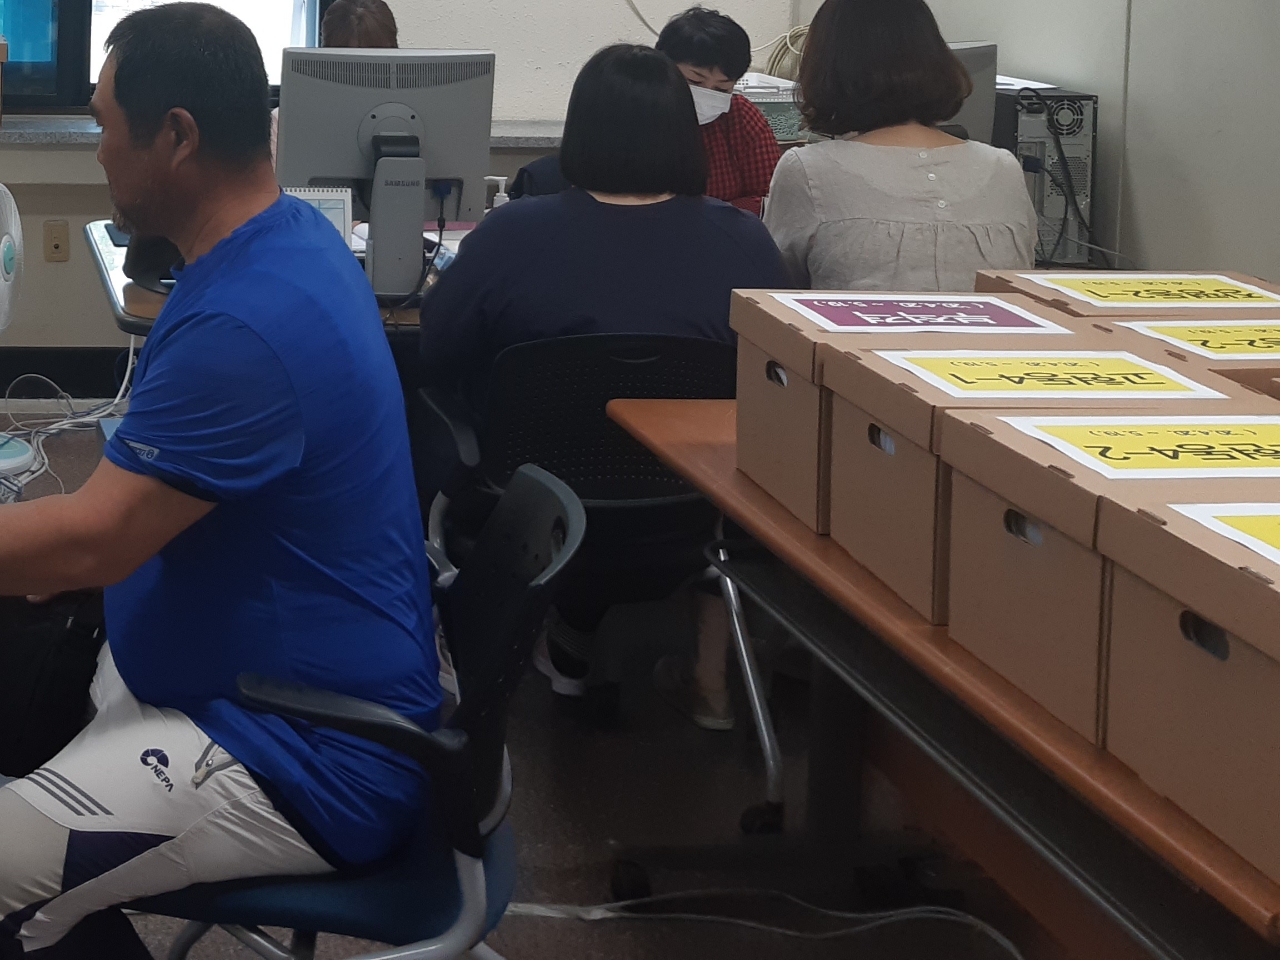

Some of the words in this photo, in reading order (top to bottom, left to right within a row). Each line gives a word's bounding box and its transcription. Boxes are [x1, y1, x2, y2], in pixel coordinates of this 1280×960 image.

[851, 311, 998, 325] 부적격
[948, 371, 1166, 385] 고현동4-1
[1082, 443, 1280, 461] 현동4-2
